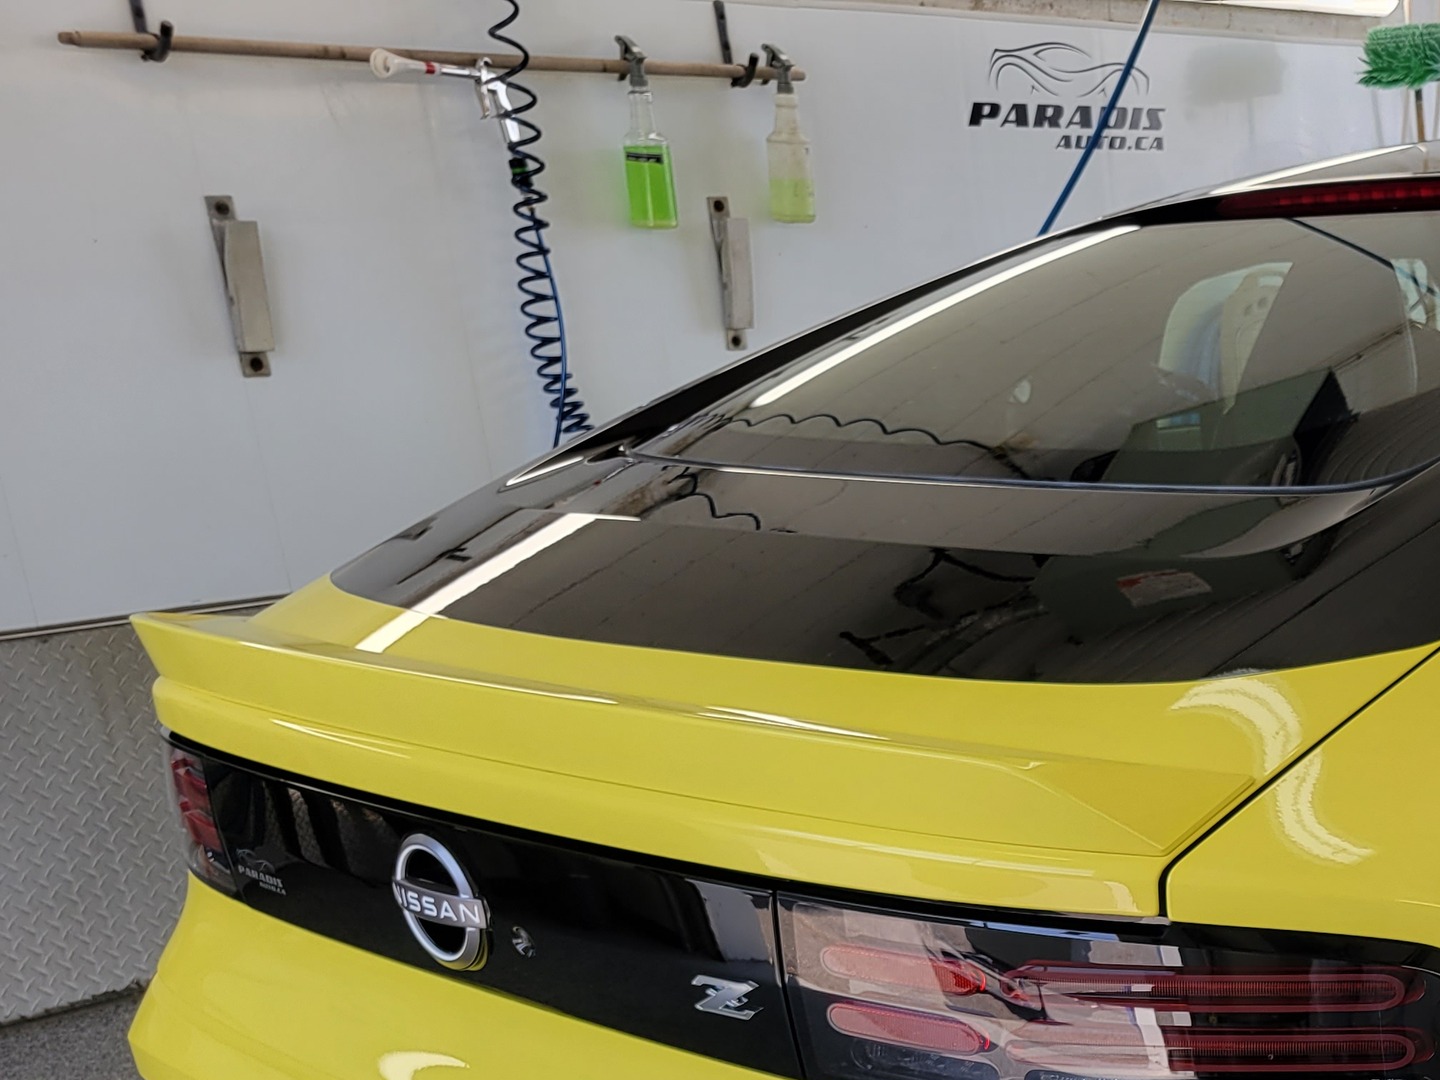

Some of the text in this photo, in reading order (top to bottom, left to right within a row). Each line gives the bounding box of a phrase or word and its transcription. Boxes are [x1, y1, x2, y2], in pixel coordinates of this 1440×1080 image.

[969, 101, 1166, 131] PARADIS
[1056, 134, 1165, 151] AUTO.CA
[392, 881, 480, 924] NISSAN
